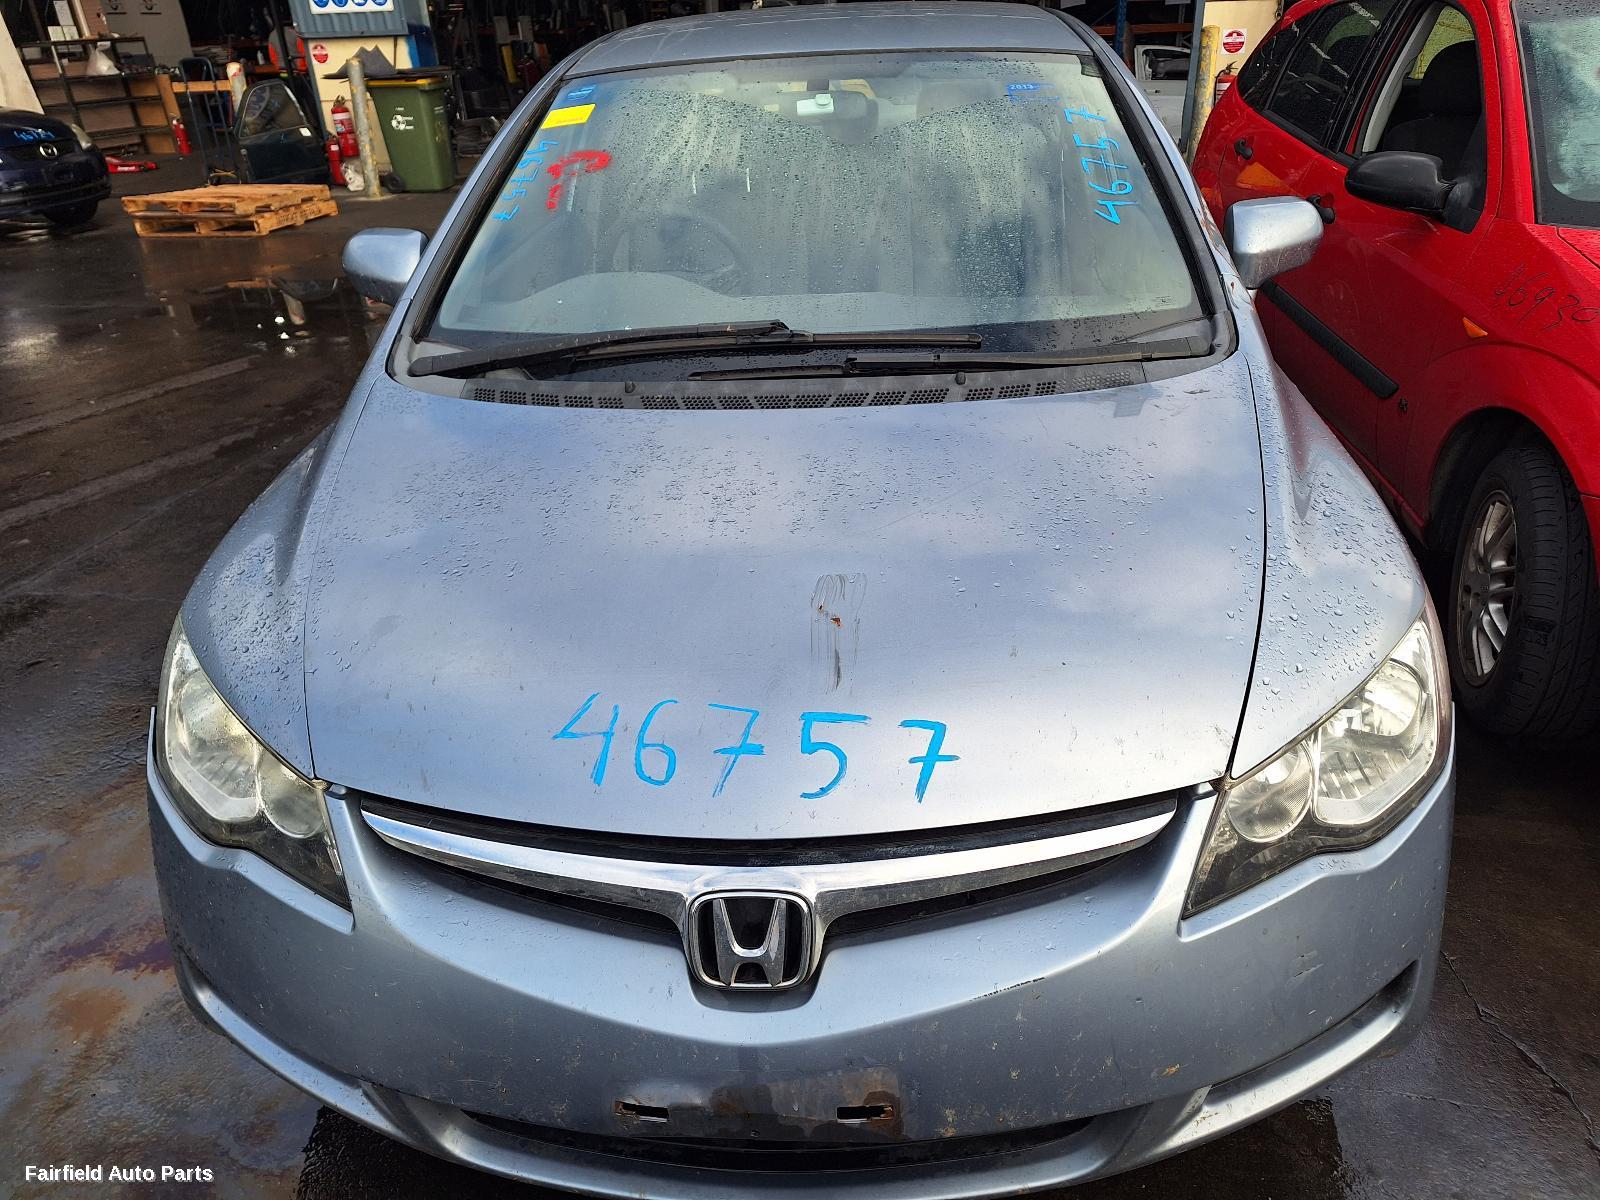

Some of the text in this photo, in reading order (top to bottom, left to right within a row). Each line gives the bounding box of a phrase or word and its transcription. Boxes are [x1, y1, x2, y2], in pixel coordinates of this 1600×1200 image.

[492, 140, 559, 220] 46757
[1063, 105, 1138, 225] 46757
[552, 692, 962, 804] 46757
